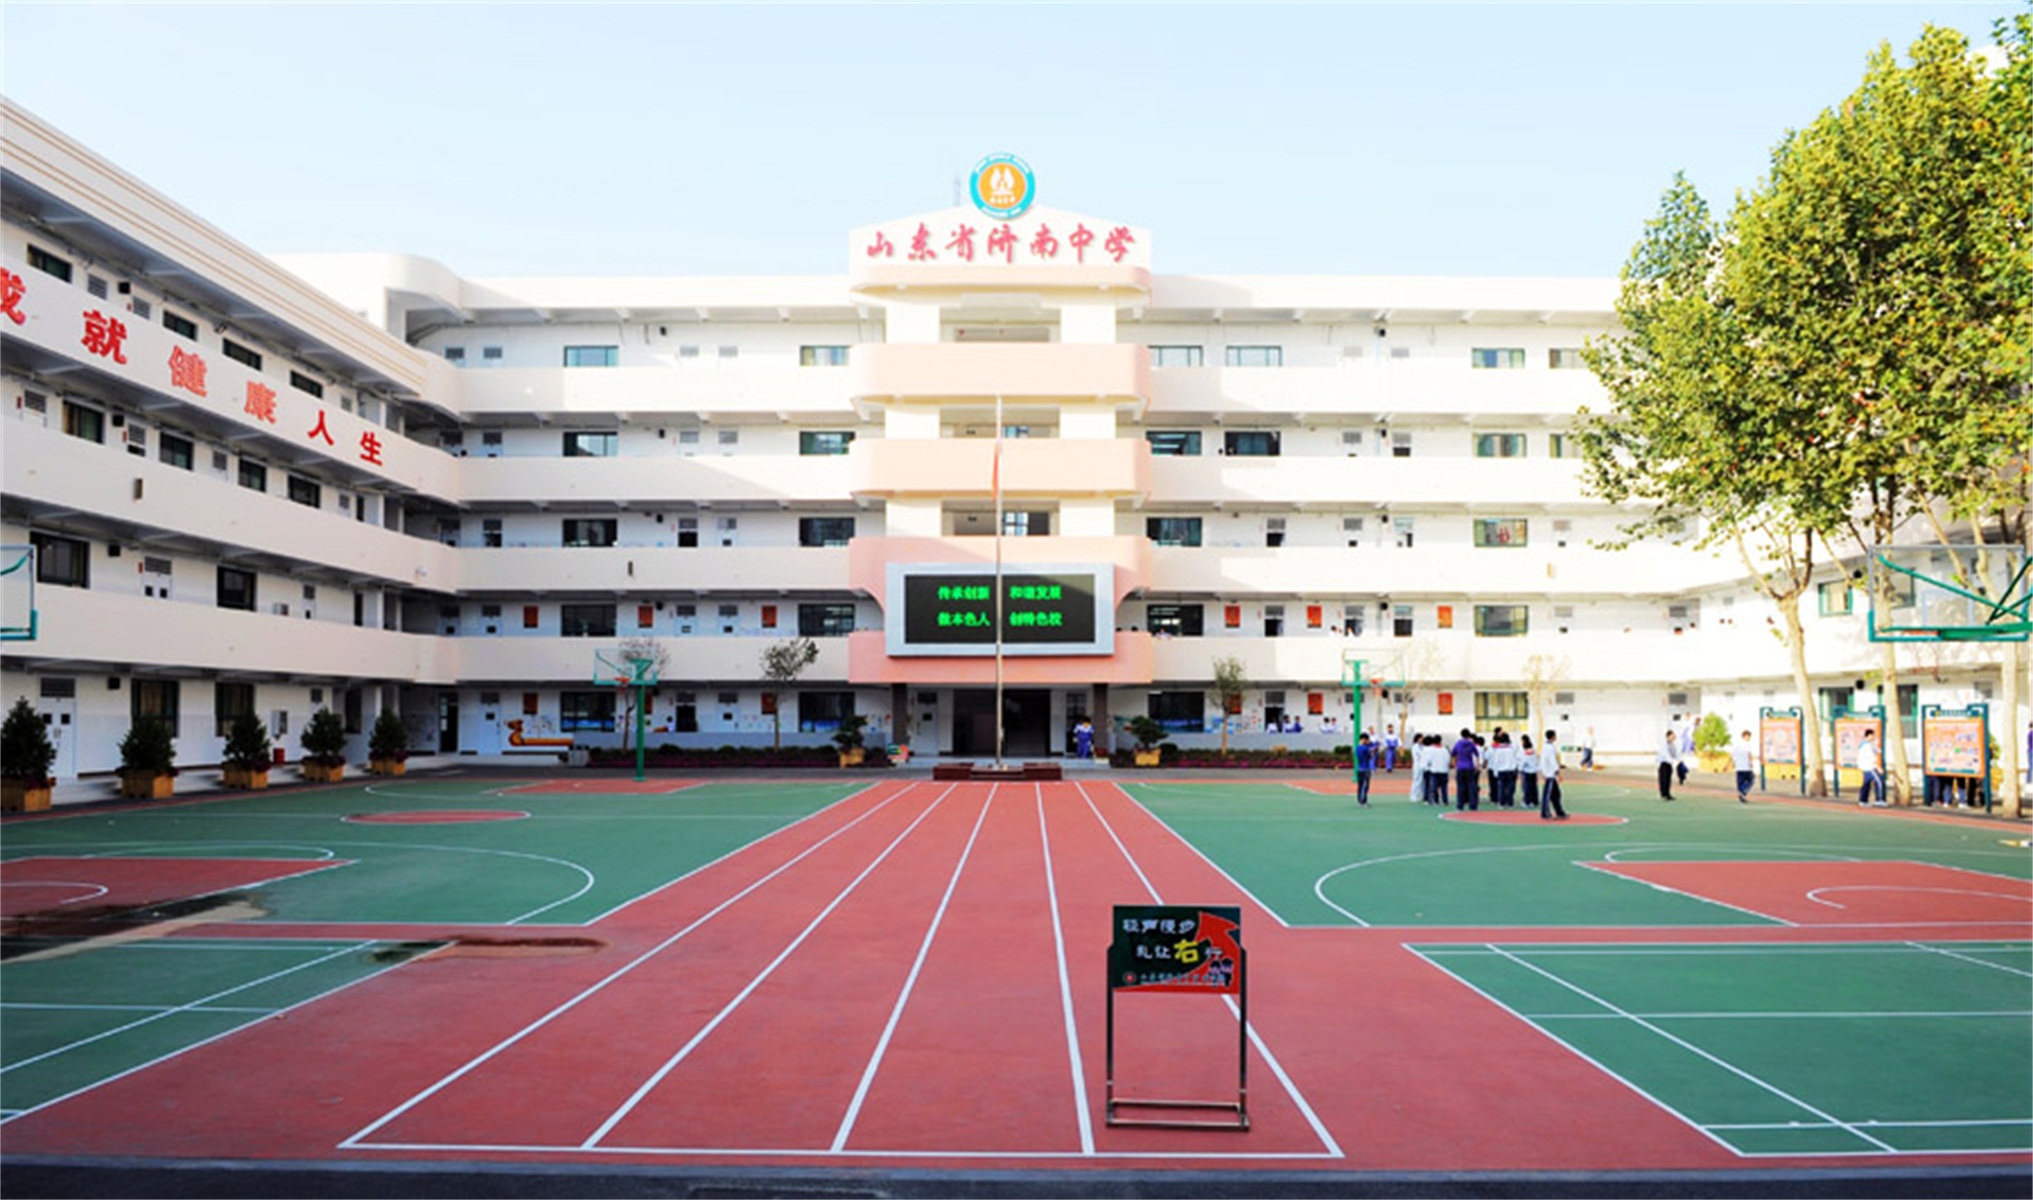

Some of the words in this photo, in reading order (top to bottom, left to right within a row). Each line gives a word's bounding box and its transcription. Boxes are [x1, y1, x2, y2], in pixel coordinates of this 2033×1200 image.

[867, 222, 1135, 263] 山东省济南中学
[1009, 585, 1063, 601] 和谐发展
[1122, 918, 1196, 934] 轻声慢步
[1135, 939, 1224, 964] 礼让右行
